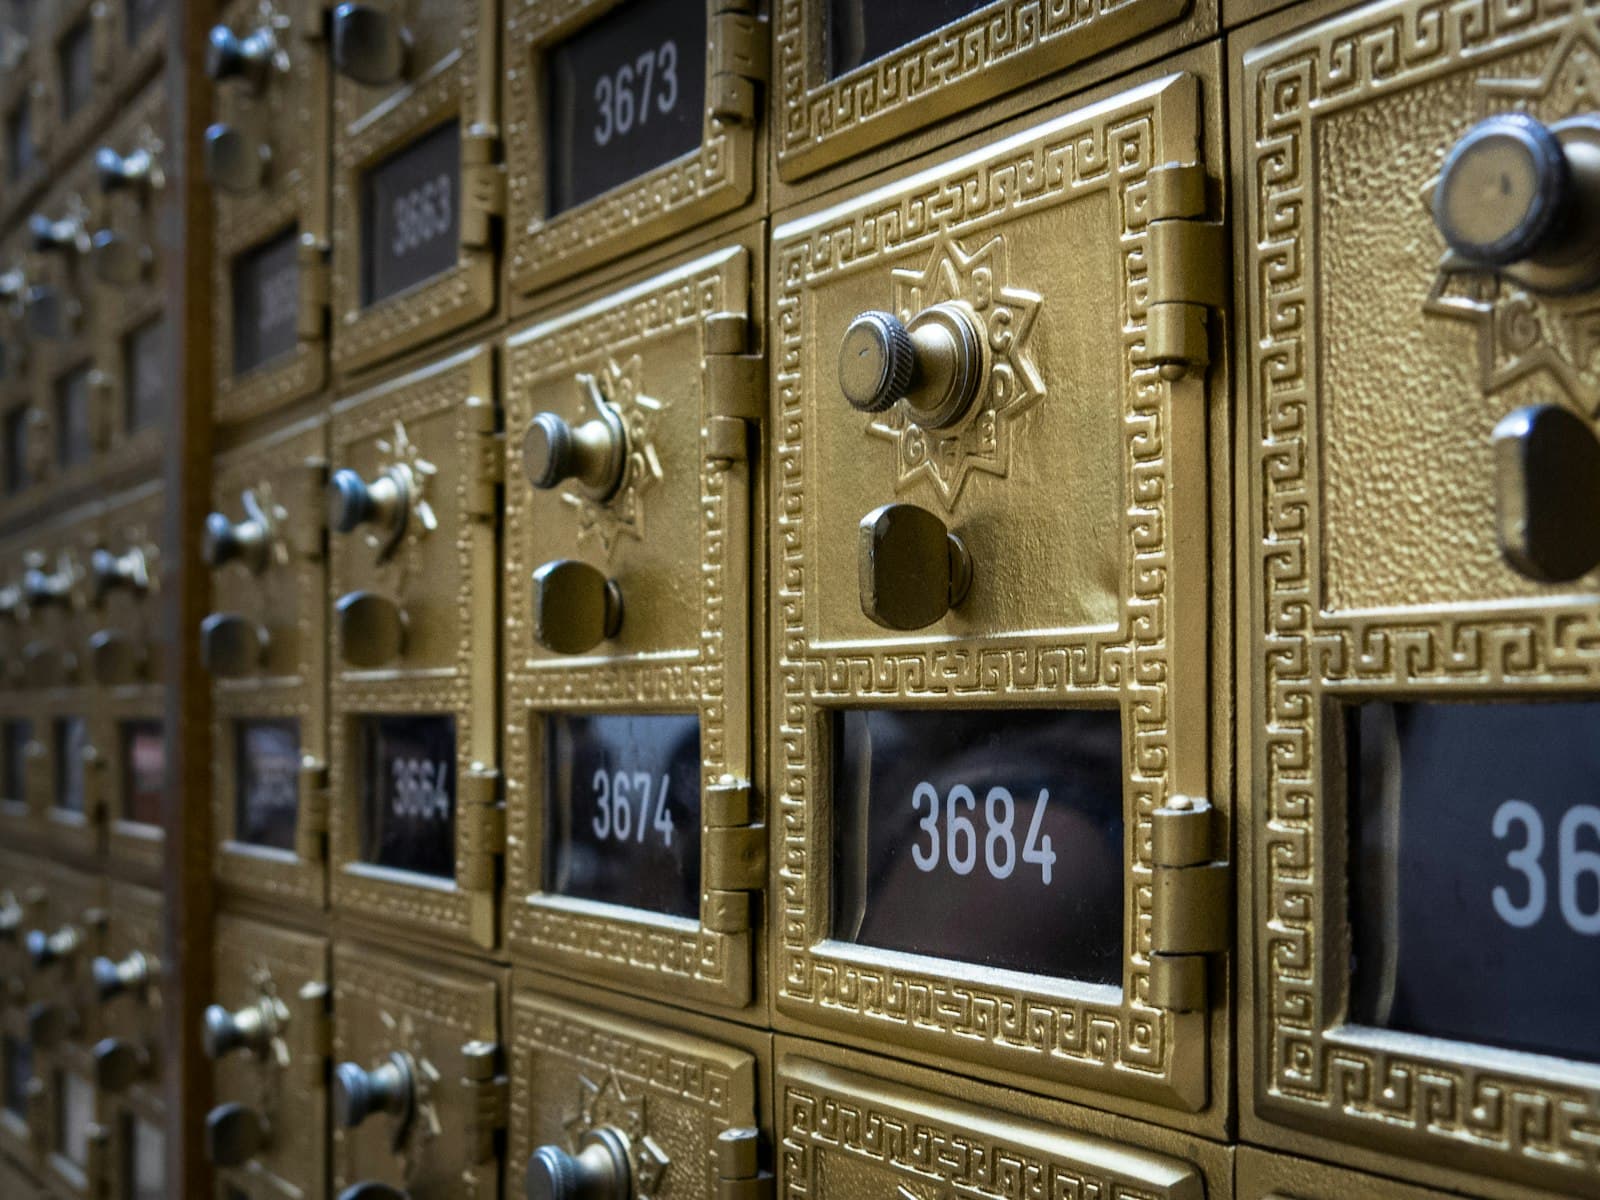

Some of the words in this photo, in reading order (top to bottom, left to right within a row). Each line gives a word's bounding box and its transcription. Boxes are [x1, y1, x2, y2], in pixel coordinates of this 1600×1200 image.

[593, 39, 678, 146] 3673
[988, 306, 1013, 348] C
[592, 768, 674, 847] 3674
[911, 780, 1057, 886] 3684
